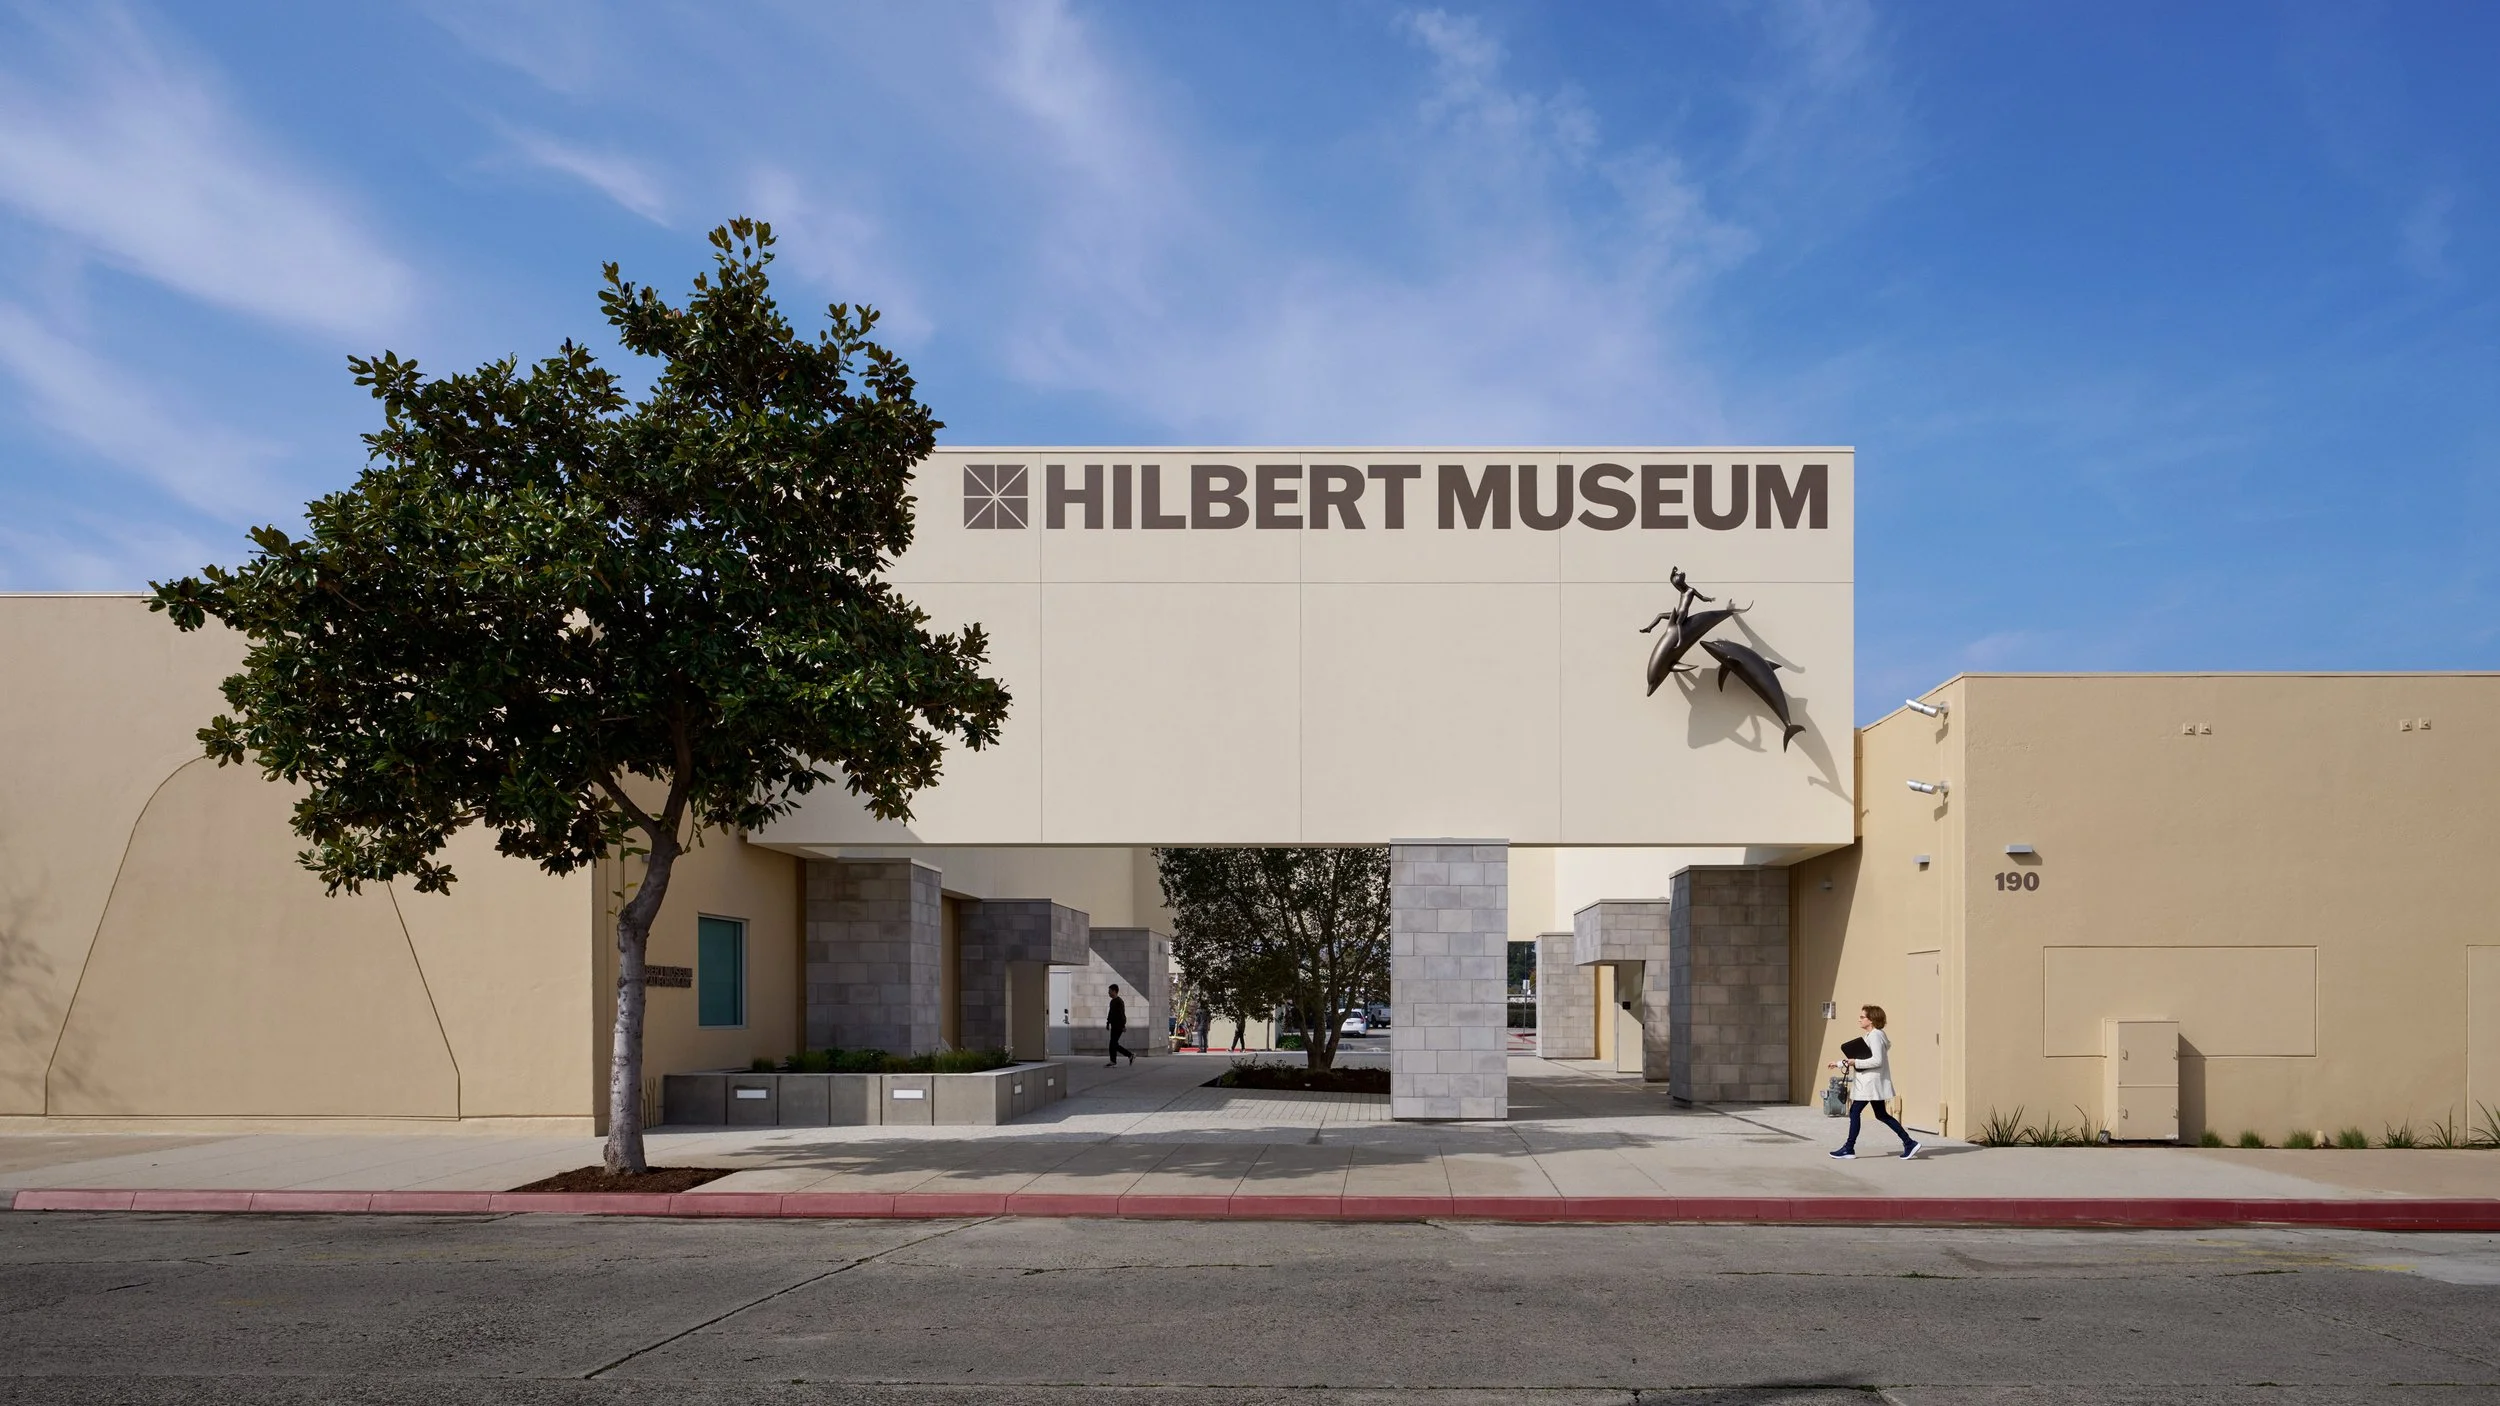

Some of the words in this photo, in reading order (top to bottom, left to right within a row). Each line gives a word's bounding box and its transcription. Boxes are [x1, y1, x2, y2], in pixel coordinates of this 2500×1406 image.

[1046, 464, 1422, 530] HILBERT
[1437, 463, 1829, 531] MUSEUM
[1994, 871, 2040, 892] 190
[645, 965, 664, 977] BERT
